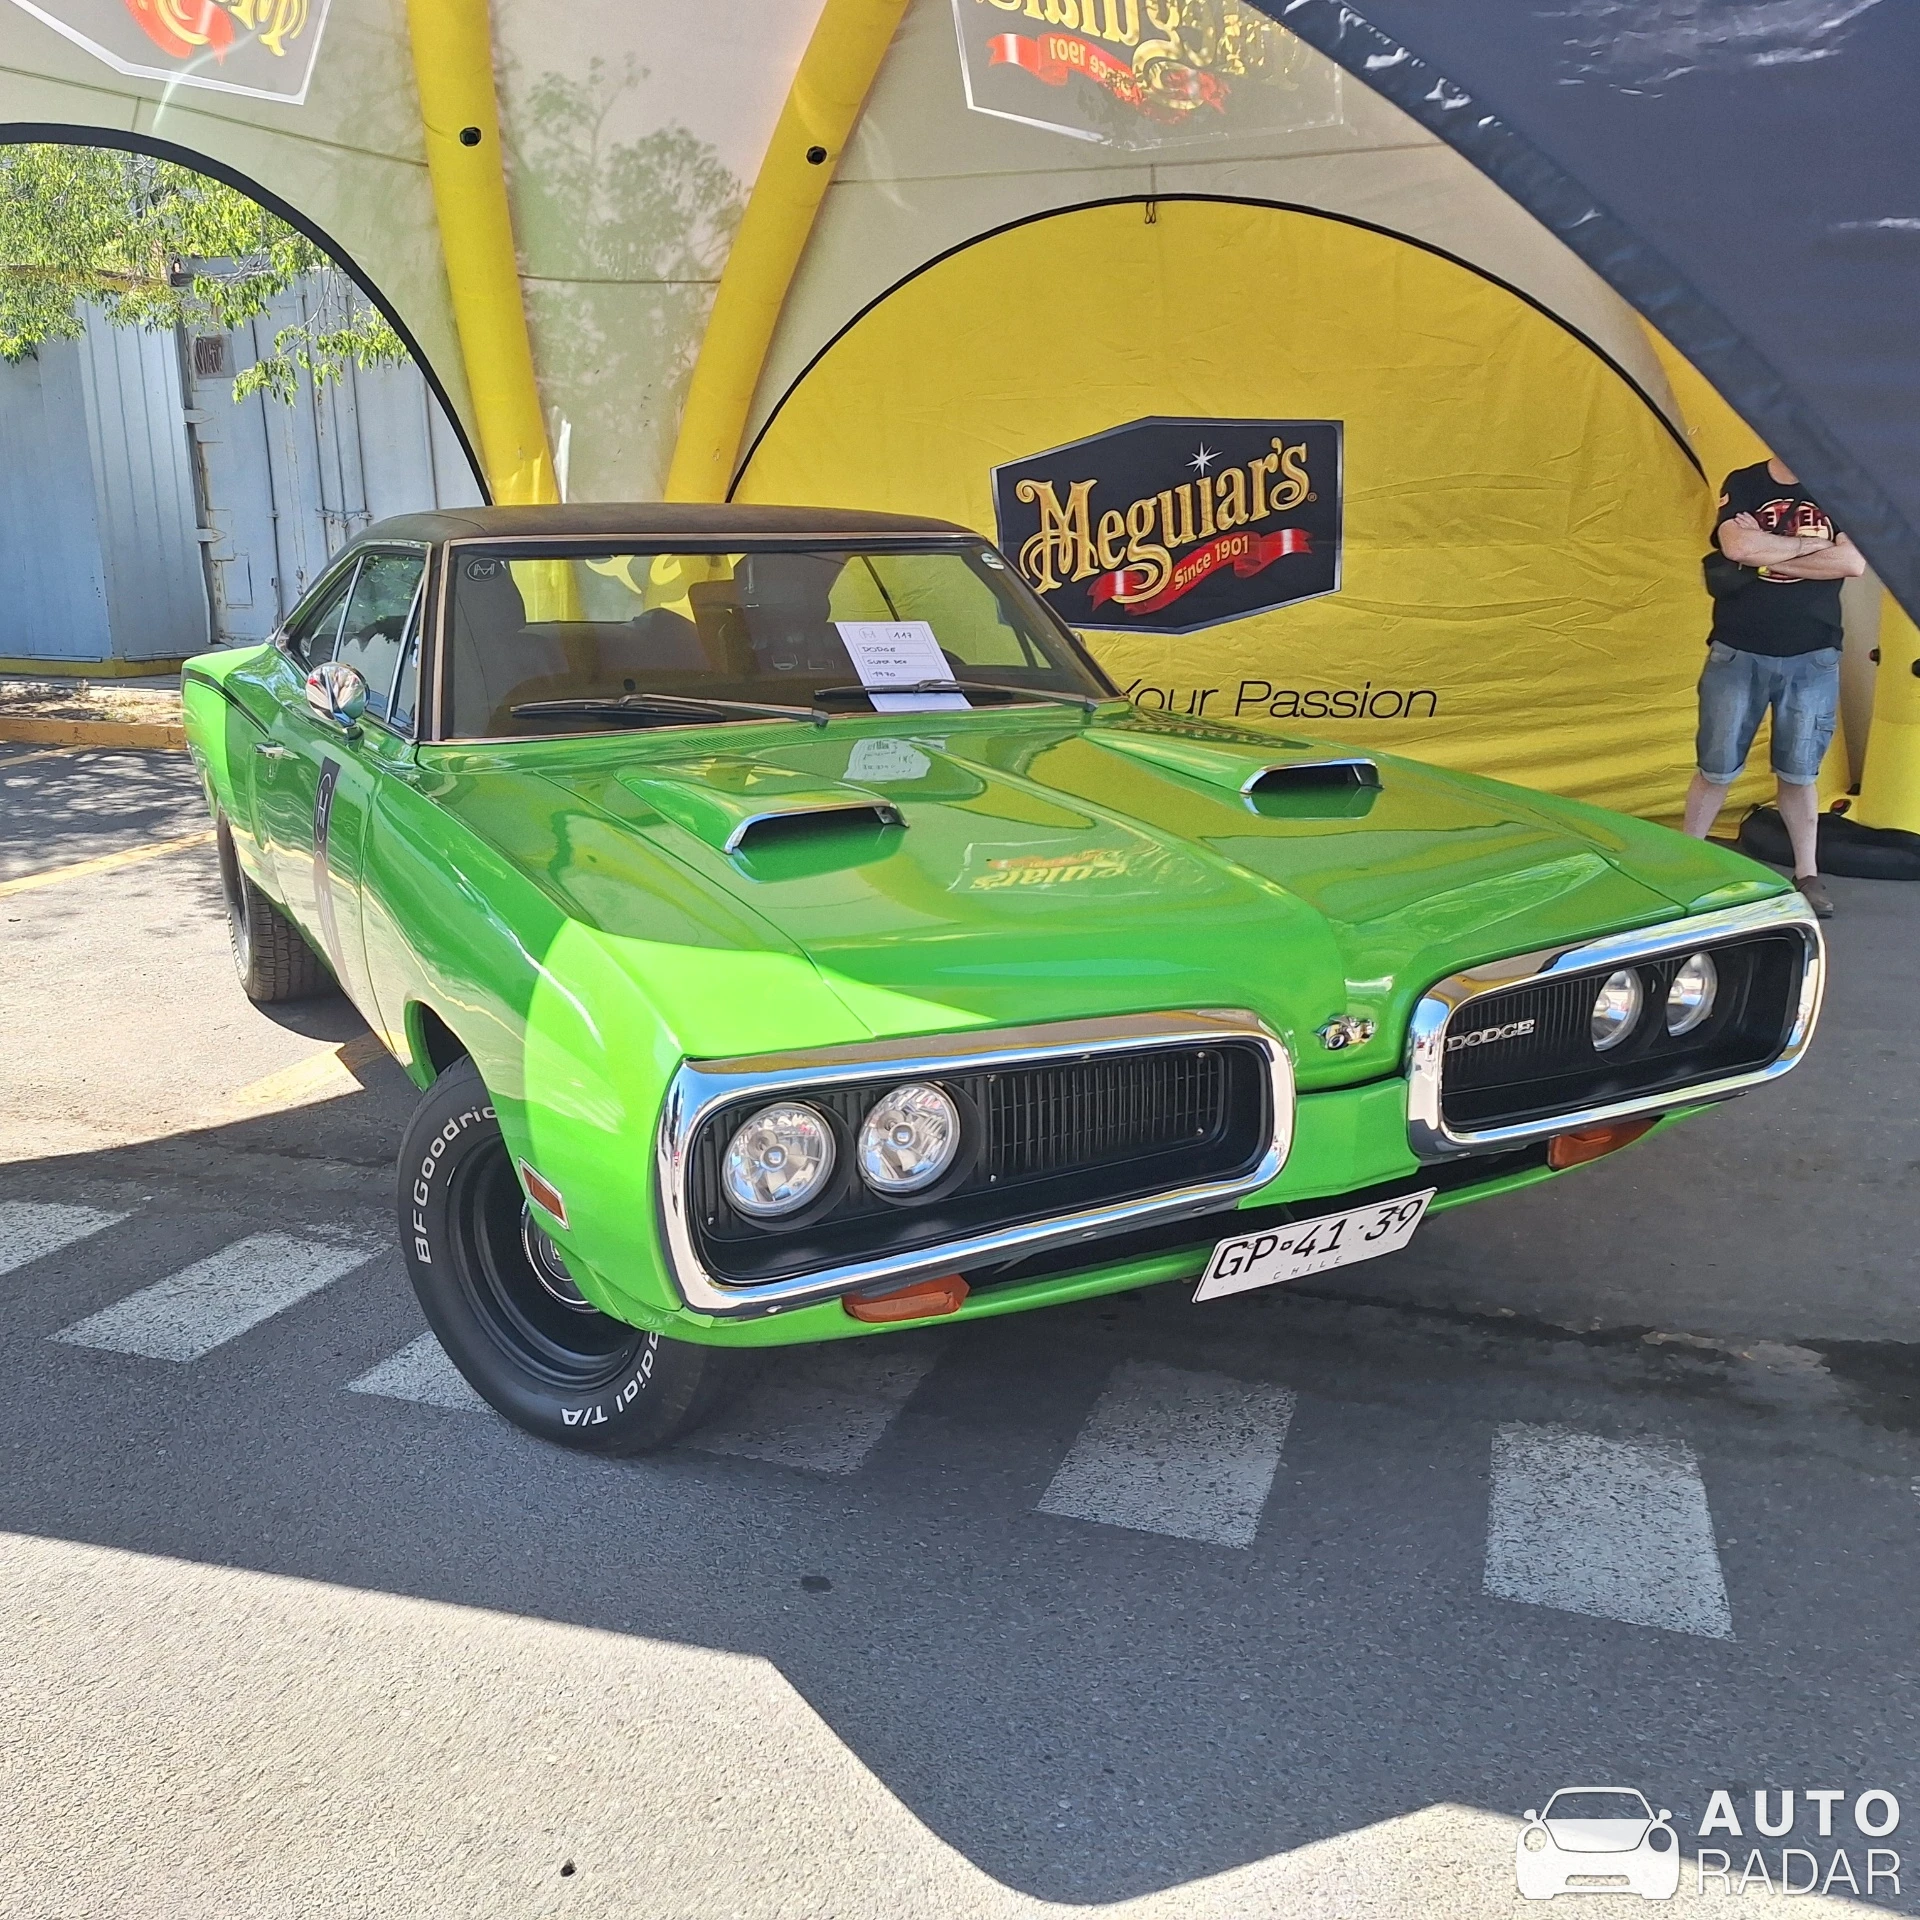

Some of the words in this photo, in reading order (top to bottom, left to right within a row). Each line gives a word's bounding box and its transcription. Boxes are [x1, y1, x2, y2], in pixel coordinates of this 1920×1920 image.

[1015, 437, 1312, 604] Meguiar's
[1174, 556, 1212, 591] Since
[1215, 535, 1250, 562] 1901
[1234, 681, 1438, 719] Passion
[1446, 1019, 1536, 1052] DODGE
[412, 1106, 500, 1265] BFGoodric
[1273, 1255, 1342, 1280] CHILE
[615, 1331, 659, 1413] adial
[561, 1405, 608, 1427] T/A
